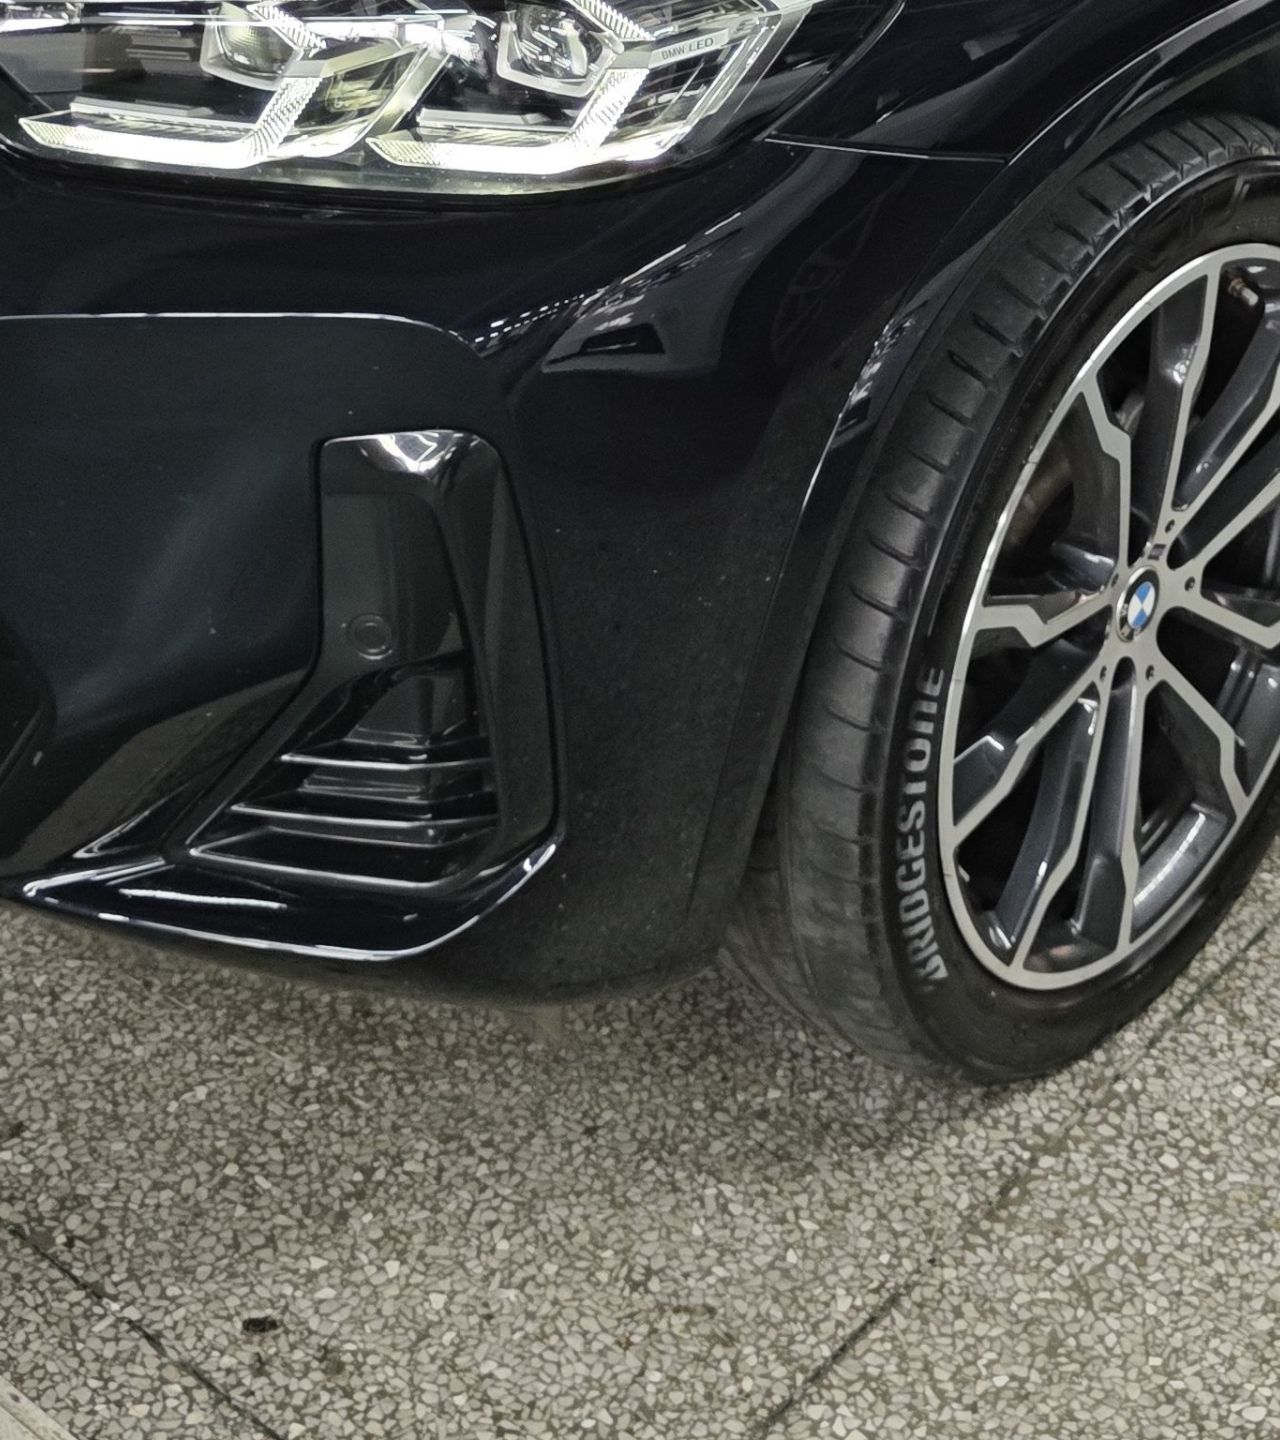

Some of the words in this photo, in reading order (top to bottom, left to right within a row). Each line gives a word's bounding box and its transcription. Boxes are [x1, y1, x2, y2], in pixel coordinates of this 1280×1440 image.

[662, 47, 686, 60] BMW
[688, 37, 714, 52] LED
[896, 667, 948, 994] BRIDGESTONE
